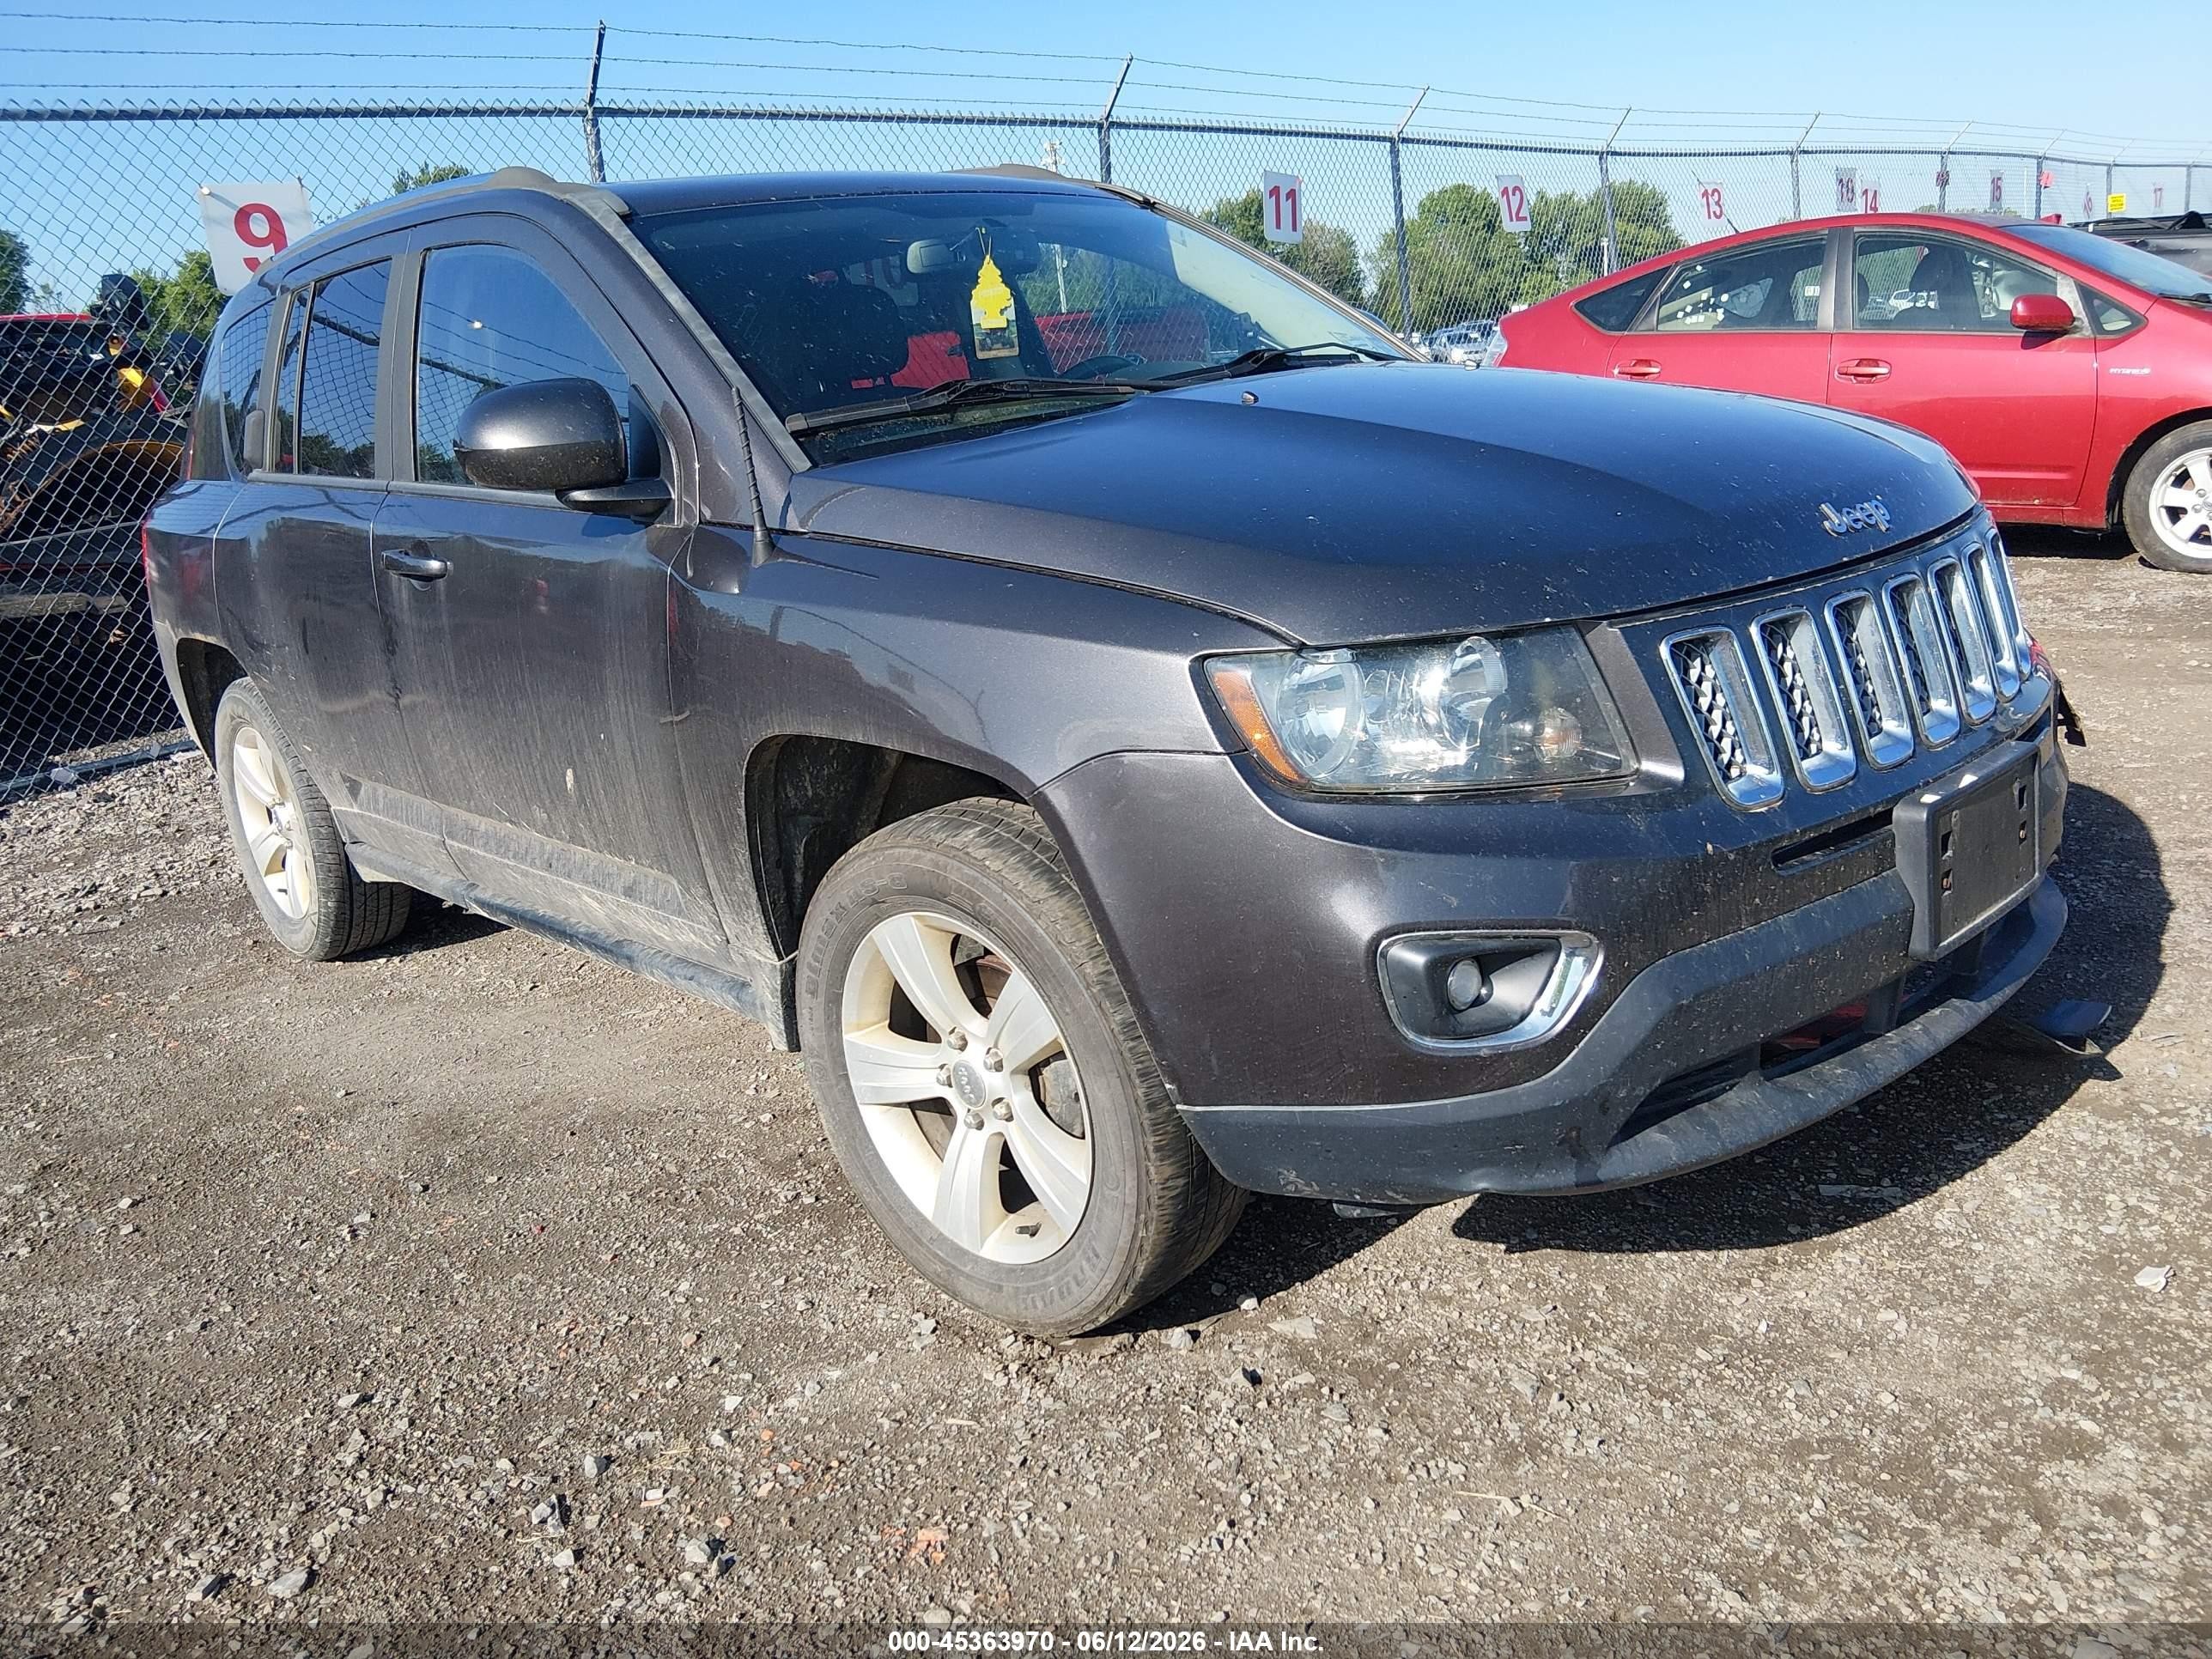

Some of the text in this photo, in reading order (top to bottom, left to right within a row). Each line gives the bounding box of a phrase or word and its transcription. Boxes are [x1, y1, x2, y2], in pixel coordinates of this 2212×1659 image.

[1269, 185, 1297, 232] 11
[1501, 185, 1528, 222] 12
[1702, 188, 1723, 220] 13
[1862, 188, 1879, 214] 14
[1990, 177, 2002, 203] 15
[234, 203, 289, 274] 9
[1820, 500, 1891, 537] Jeep
